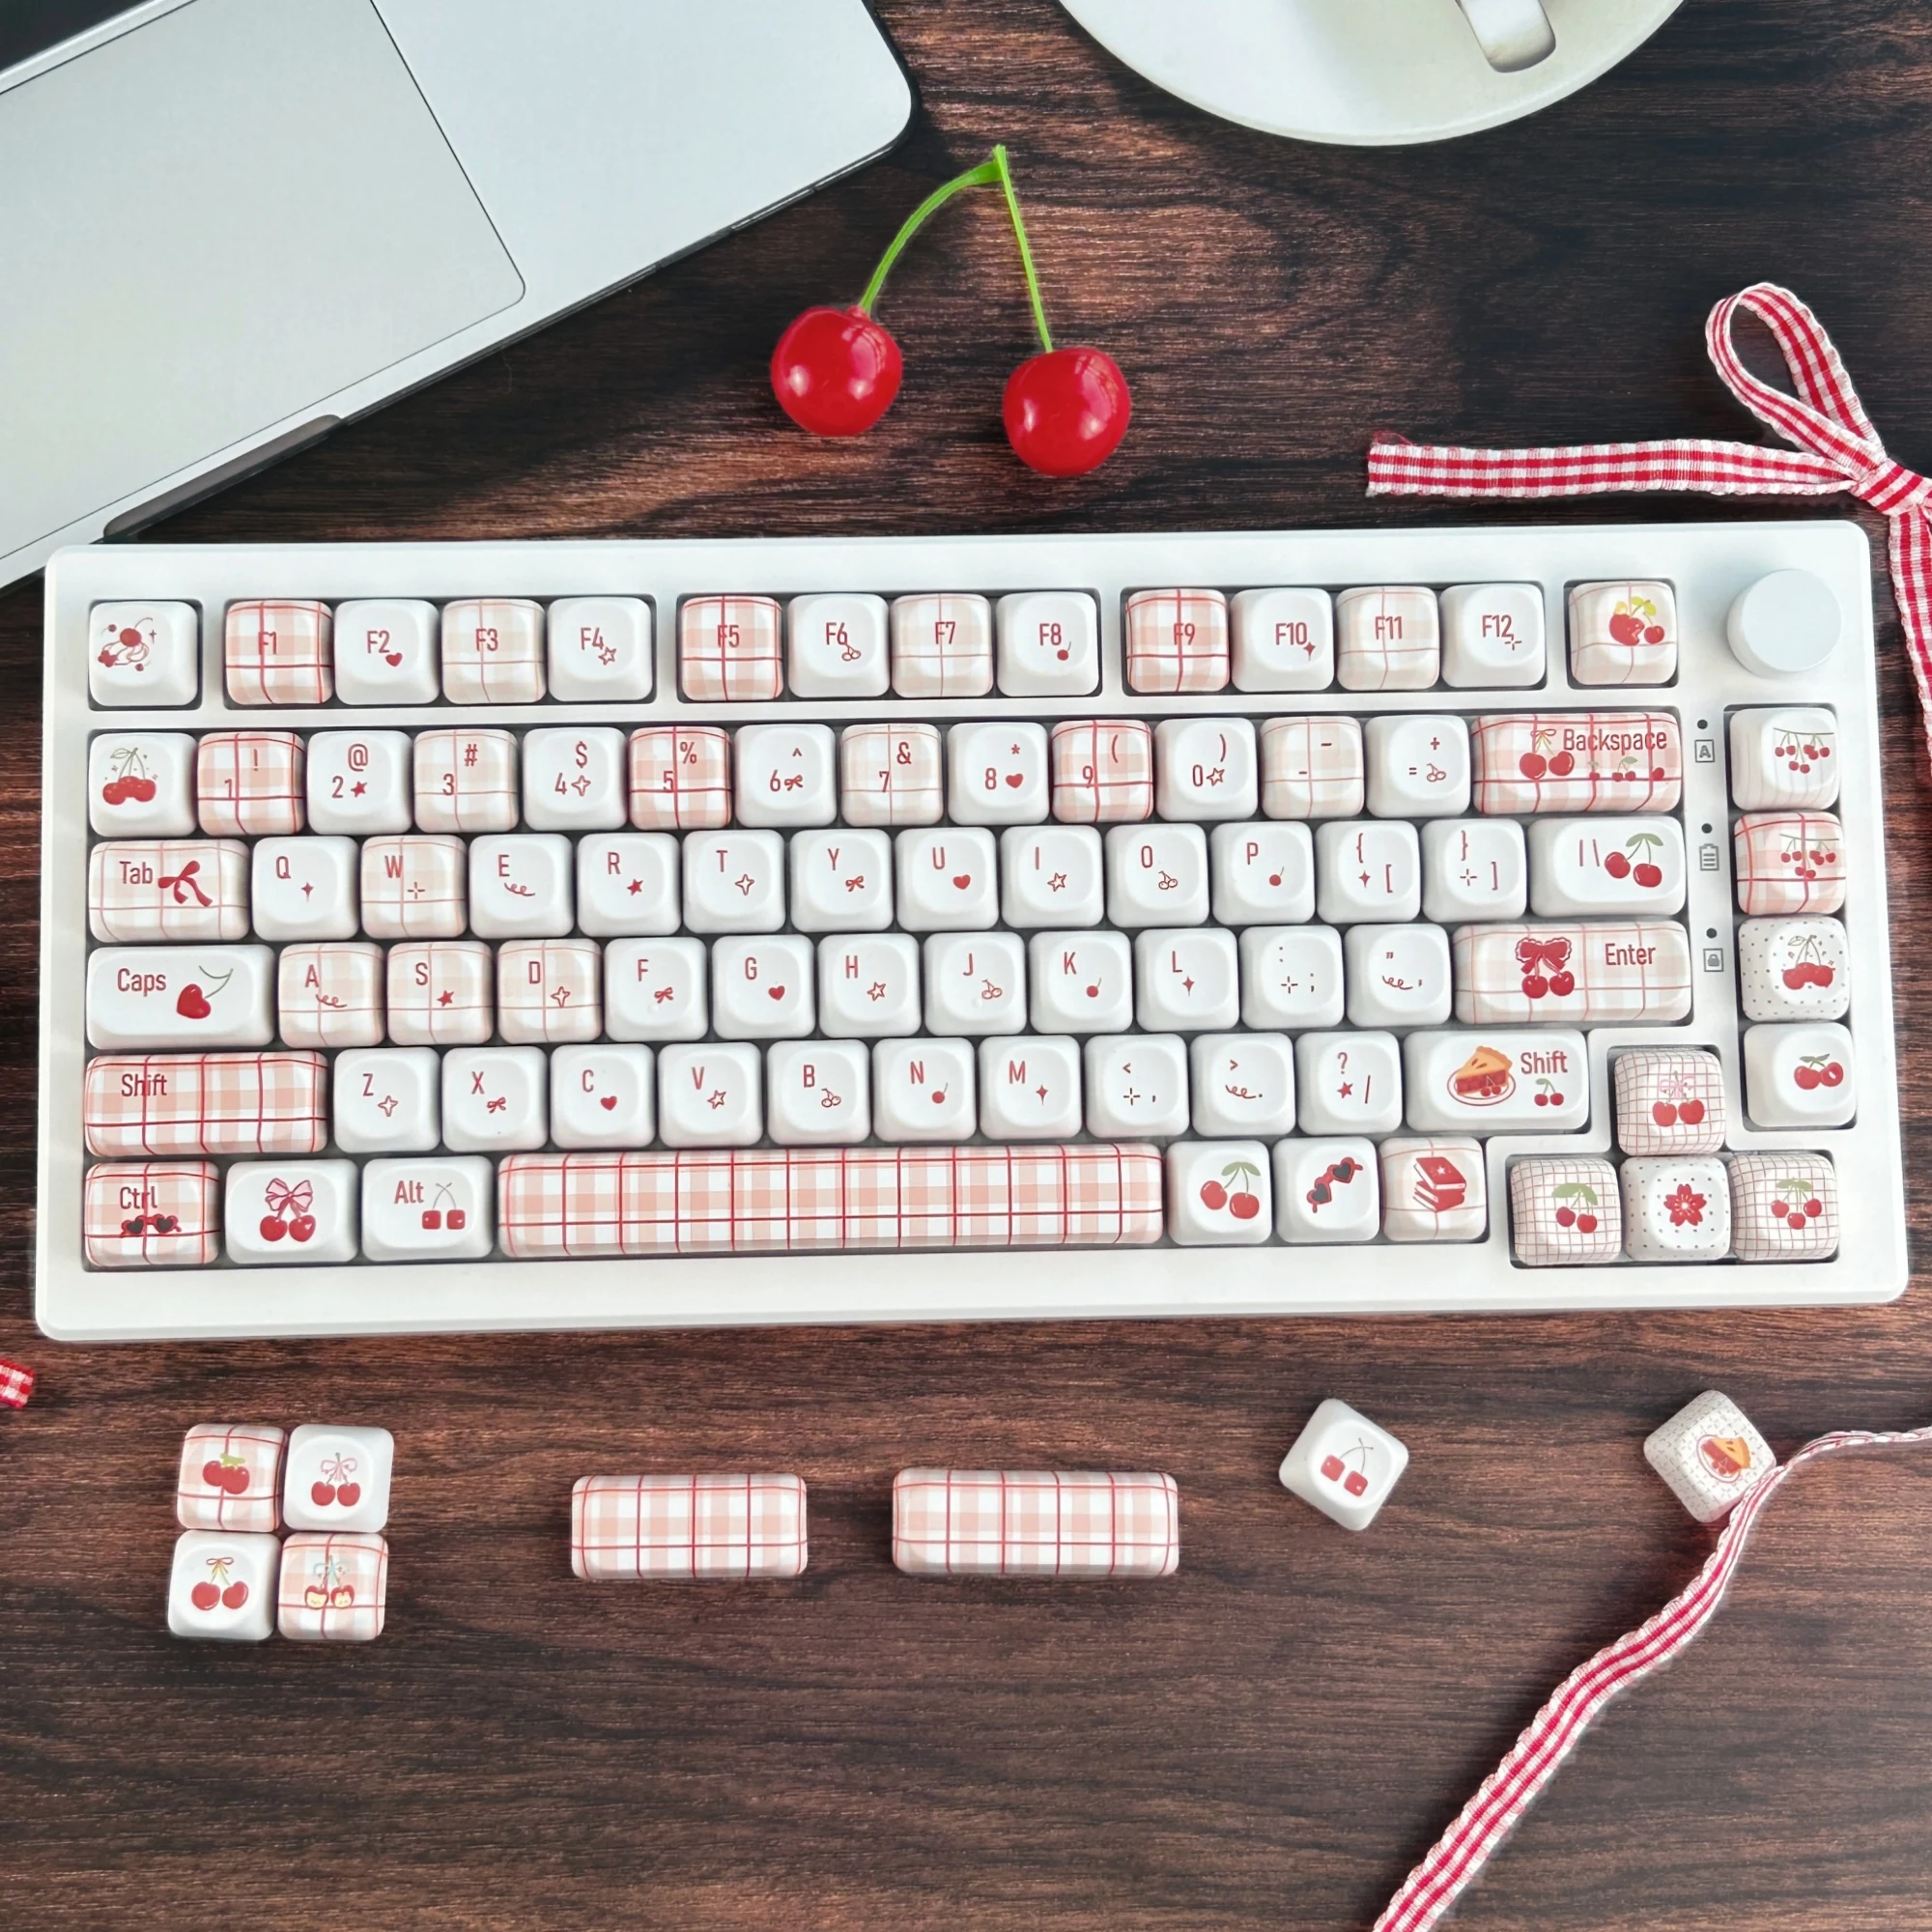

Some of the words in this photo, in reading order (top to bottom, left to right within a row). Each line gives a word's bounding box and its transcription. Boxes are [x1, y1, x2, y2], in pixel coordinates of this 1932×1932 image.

[717, 624, 740, 648] F5
[825, 621, 849, 645] F6
[934, 621, 956, 644] F7
[1038, 622, 1062, 646] F8
[1173, 620, 1196, 645] F9
[1275, 622, 1308, 646] F10
[1375, 616, 1404, 640] F11
[1481, 614, 1513, 639] F12
[258, 631, 278, 655] F1
[366, 631, 390, 654] F2
[475, 628, 498, 652] F3
[581, 627, 605, 650] F4
[1562, 727, 1667, 756] Backspace
[331, 776, 344, 798] 2
[442, 773, 455, 795] 3
[554, 773, 567, 795] 4
[663, 771, 674, 791] 5
[770, 770, 781, 792] 6
[879, 771, 890, 793] 7
[984, 767, 997, 790] 8
[1082, 766, 1094, 787] 9
[224, 779, 234, 800] 1
[607, 852, 620, 874] R
[716, 850, 728, 872] T
[828, 848, 840, 870] Y
[932, 847, 945, 869] U
[1035, 847, 1039, 869] I
[1246, 842, 1259, 865] P
[120, 861, 154, 885] Tab
[275, 856, 292, 880] Q
[384, 855, 404, 878] W
[497, 854, 511, 877] E
[963, 953, 974, 977] J
[1064, 952, 1077, 975] K
[1172, 951, 1183, 974] L
[1605, 943, 1657, 966] Enter
[304, 965, 318, 988] A
[415, 962, 429, 986] S
[528, 961, 541, 984] D
[638, 959, 649, 981] F
[744, 957, 758, 980] G
[845, 955, 858, 978] H
[117, 969, 166, 996] Caps
[910, 1061, 924, 1084] N
[1009, 1061, 1026, 1084] M
[1520, 1051, 1568, 1075] Shift
[121, 1073, 168, 1097] Shift
[362, 1073, 374, 1096] Z
[470, 1071, 485, 1094] X
[582, 1069, 594, 1093] C
[692, 1066, 704, 1090] V
[803, 1065, 815, 1088] B
[119, 1185, 157, 1210] Ctrl
[394, 1179, 425, 1205] Alt
